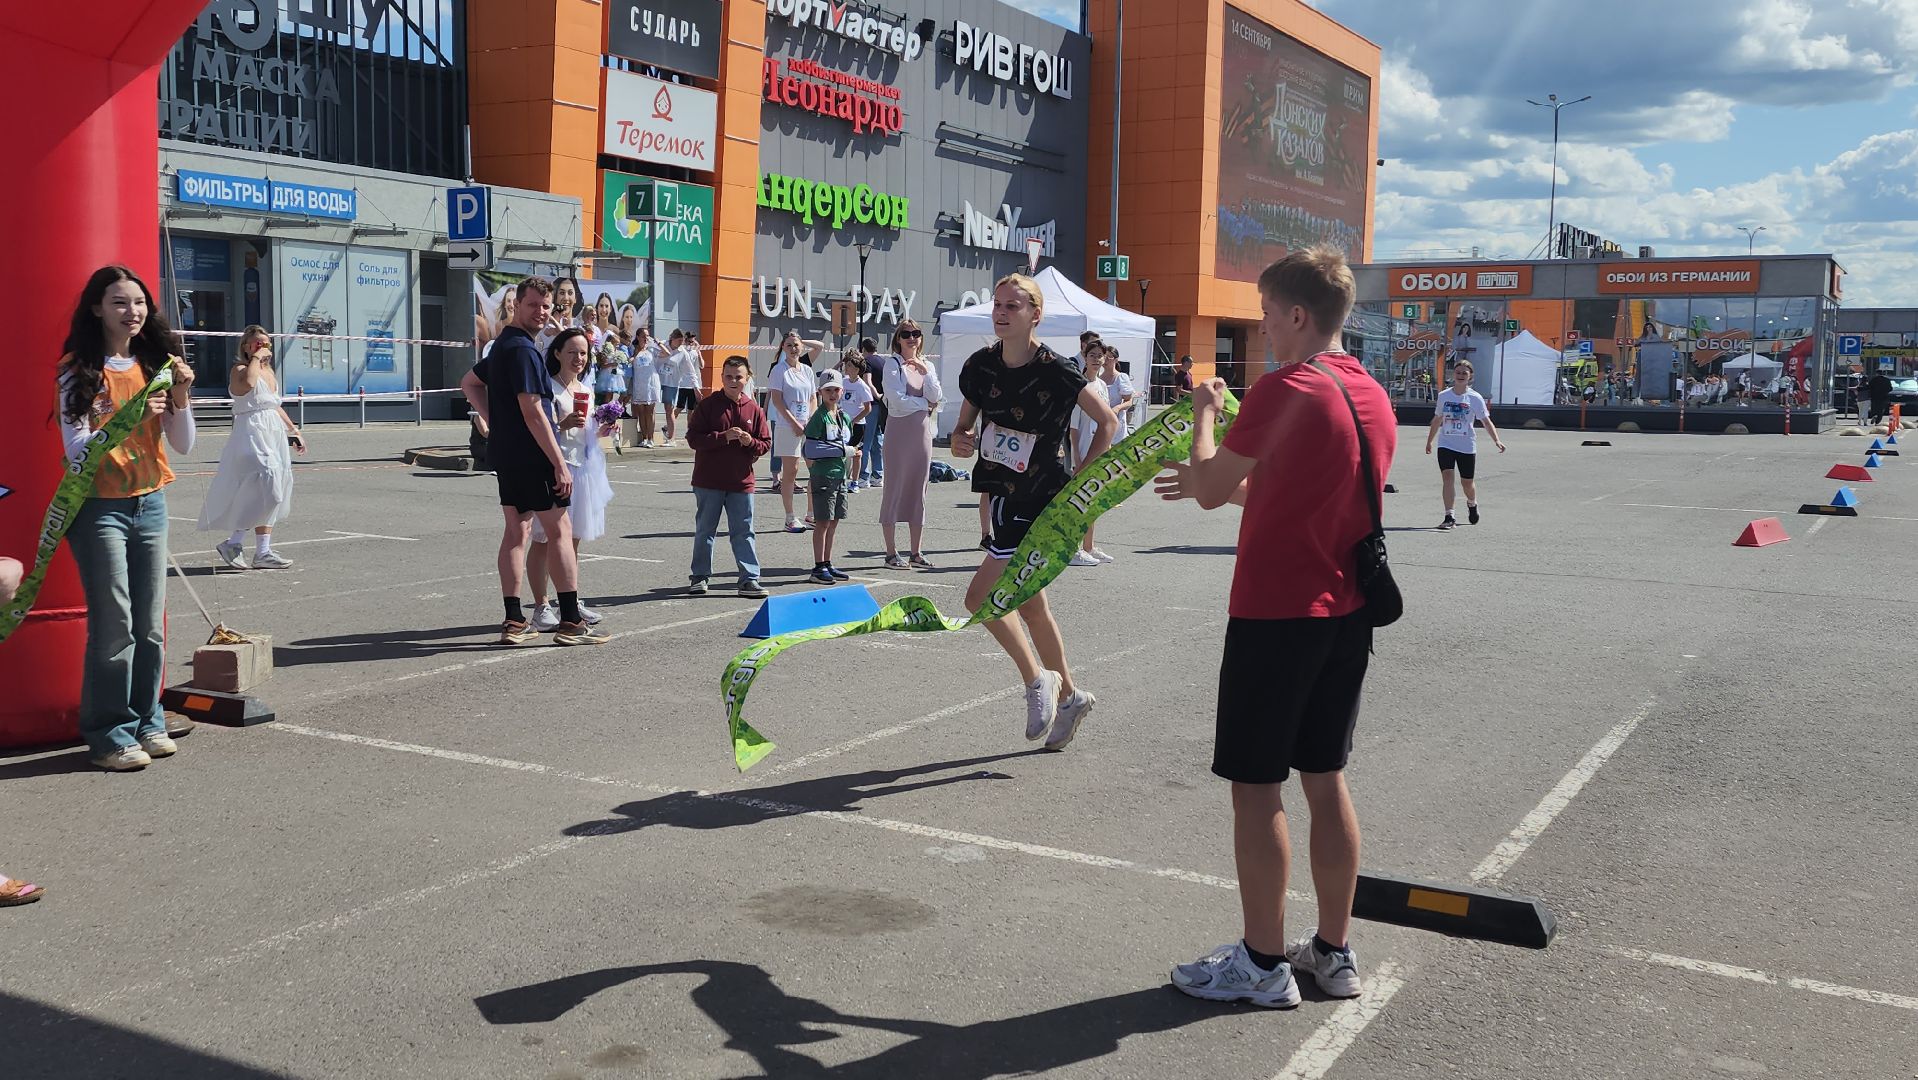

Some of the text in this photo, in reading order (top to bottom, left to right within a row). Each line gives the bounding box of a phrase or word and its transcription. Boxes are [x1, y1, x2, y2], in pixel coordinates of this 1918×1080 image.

[630, 6, 700, 47] СУДАРЬ
[1232, 19, 1272, 51] 14 СЕНТЯБРЯ
[954, 20, 1072, 100] РИВ ГОШ
[193, 43, 341, 105] МАСКА
[763, 57, 903, 138] Леонардо
[158, 97, 318, 153] РАЦИИ
[617, 120, 705, 161] Теремок
[184, 176, 353, 215] ФИЛЬТРЫ ДЛЯ ВОДЫ
[635, 191, 646, 210] 7
[663, 192, 672, 211] 7
[456, 193, 479, 235] P
[290, 256, 340, 271] Осмос для
[359, 262, 398, 276] Соль для
[1103, 261, 1112, 274] 8
[302, 272, 330, 284] кухни
[356, 274, 401, 288] фильтров
[1401, 272, 1467, 291] ОБОИ
[1606, 271, 1751, 284] ОБОИ ИЗ ГЕРМАНИИ
[1396, 339, 1438, 351] ОБОИ
[1696, 338, 1745, 351] ОБОИ
[1844, 337, 1858, 353] P
[995, 433, 1020, 453] 76
